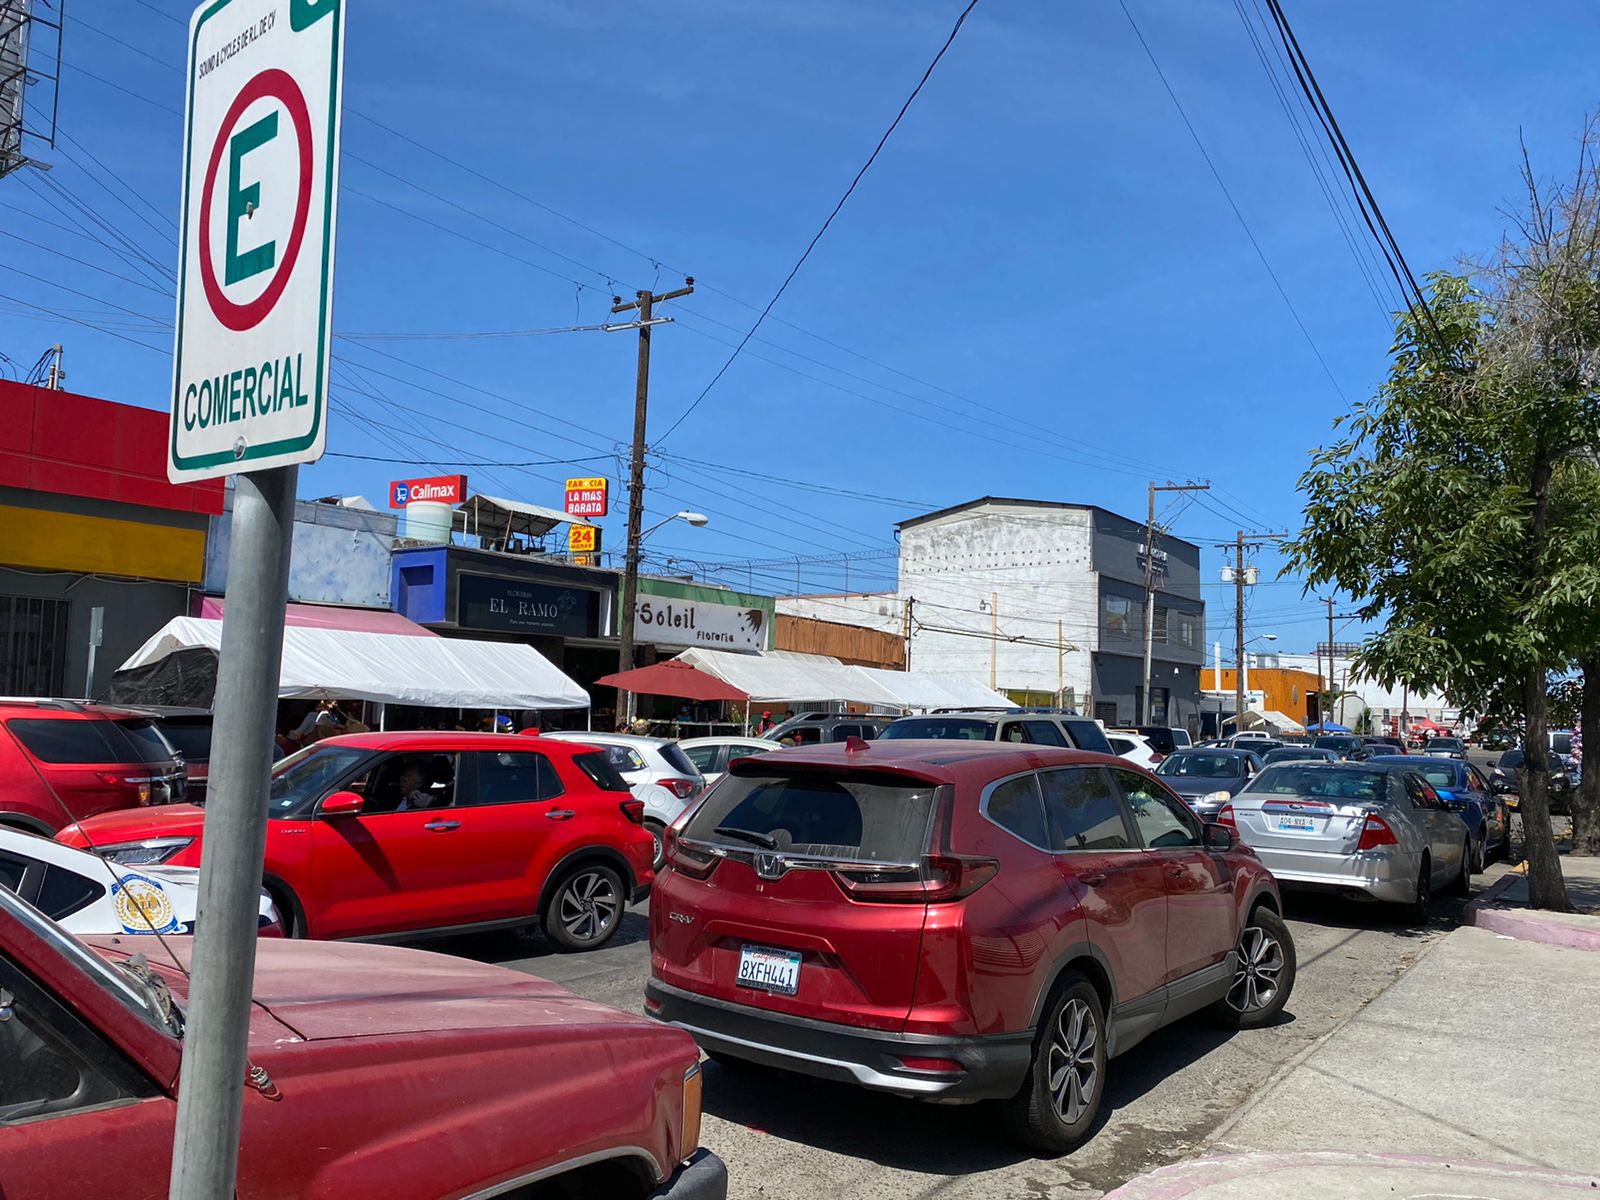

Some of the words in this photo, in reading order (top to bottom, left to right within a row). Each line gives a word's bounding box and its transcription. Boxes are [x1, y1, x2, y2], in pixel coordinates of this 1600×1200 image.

[199, 54, 215, 79] SOUND
[220, 36, 241, 64] CYCLES
[241, 29, 249, 49] DE
[259, 15, 268, 36] DE
[268, 9, 276, 30] CV
[225, 110, 279, 287] E
[184, 352, 308, 432] COMERCIAL
[411, 484, 454, 500] Calimax
[568, 491, 579, 502] LA
[581, 491, 602, 502] MAS
[568, 502, 602, 514] BARATA
[572, 531, 592, 543] 24
[489, 598, 508, 614] EL
[518, 601, 558, 618] RAMO
[640, 602, 695, 630] Soleil
[696, 630, 735, 643] Floreria
[740, 959, 793, 987] 8XFH441
